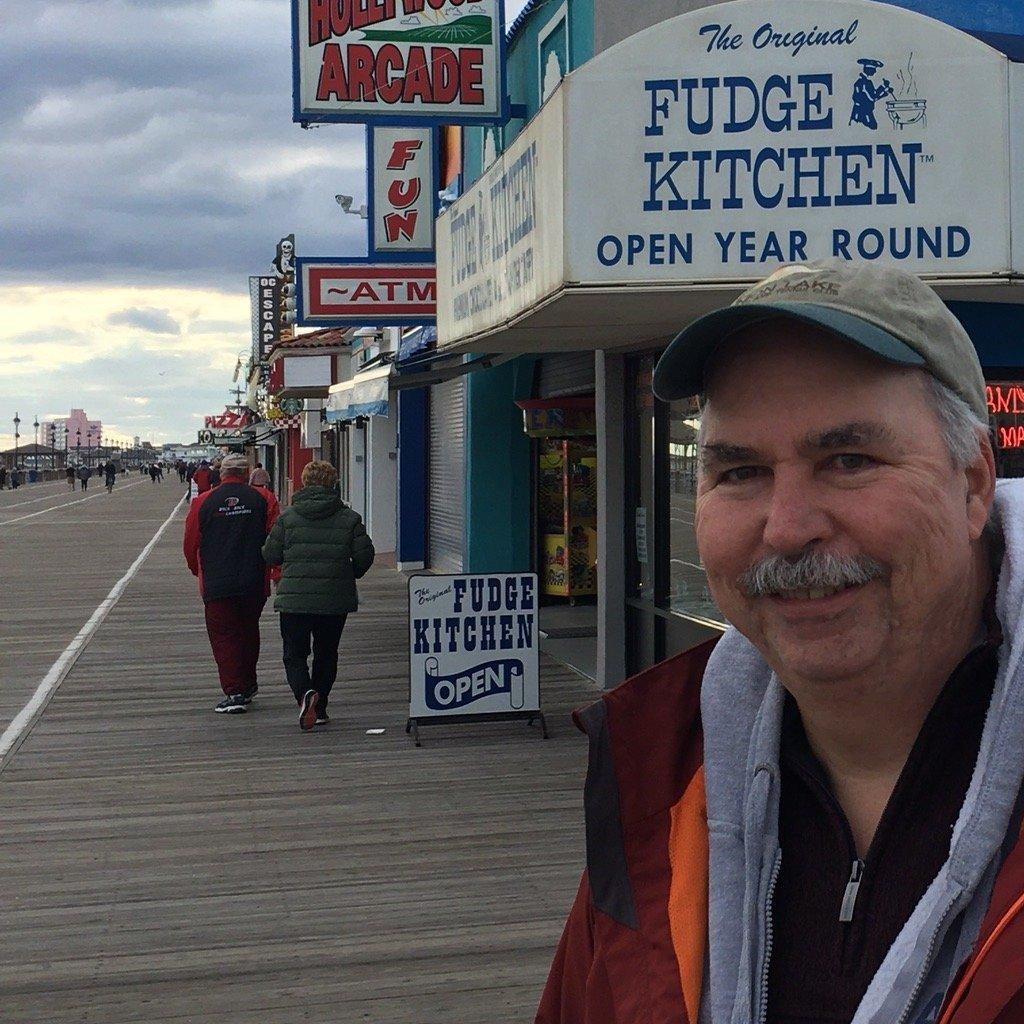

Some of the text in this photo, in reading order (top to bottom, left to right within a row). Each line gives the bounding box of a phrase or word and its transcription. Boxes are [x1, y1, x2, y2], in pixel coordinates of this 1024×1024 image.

[699, 19, 858, 57] The Original
[316, 43, 484, 105] ARCADE
[644, 74, 833, 136] FUDGE
[383, 139, 423, 243] FUN
[643, 143, 922, 212] KITCHEN
[597, 225, 971, 267] OPEN YEAR ROUND
[260, 278, 276, 287] OC
[204, 413, 250, 428] PIZZA
[414, 587, 430, 598] The
[418, 585, 451, 606] Original
[453, 577, 534, 613] FUDGE
[414, 614, 534, 654] KITCHEN
[434, 664, 504, 705] OPEN
